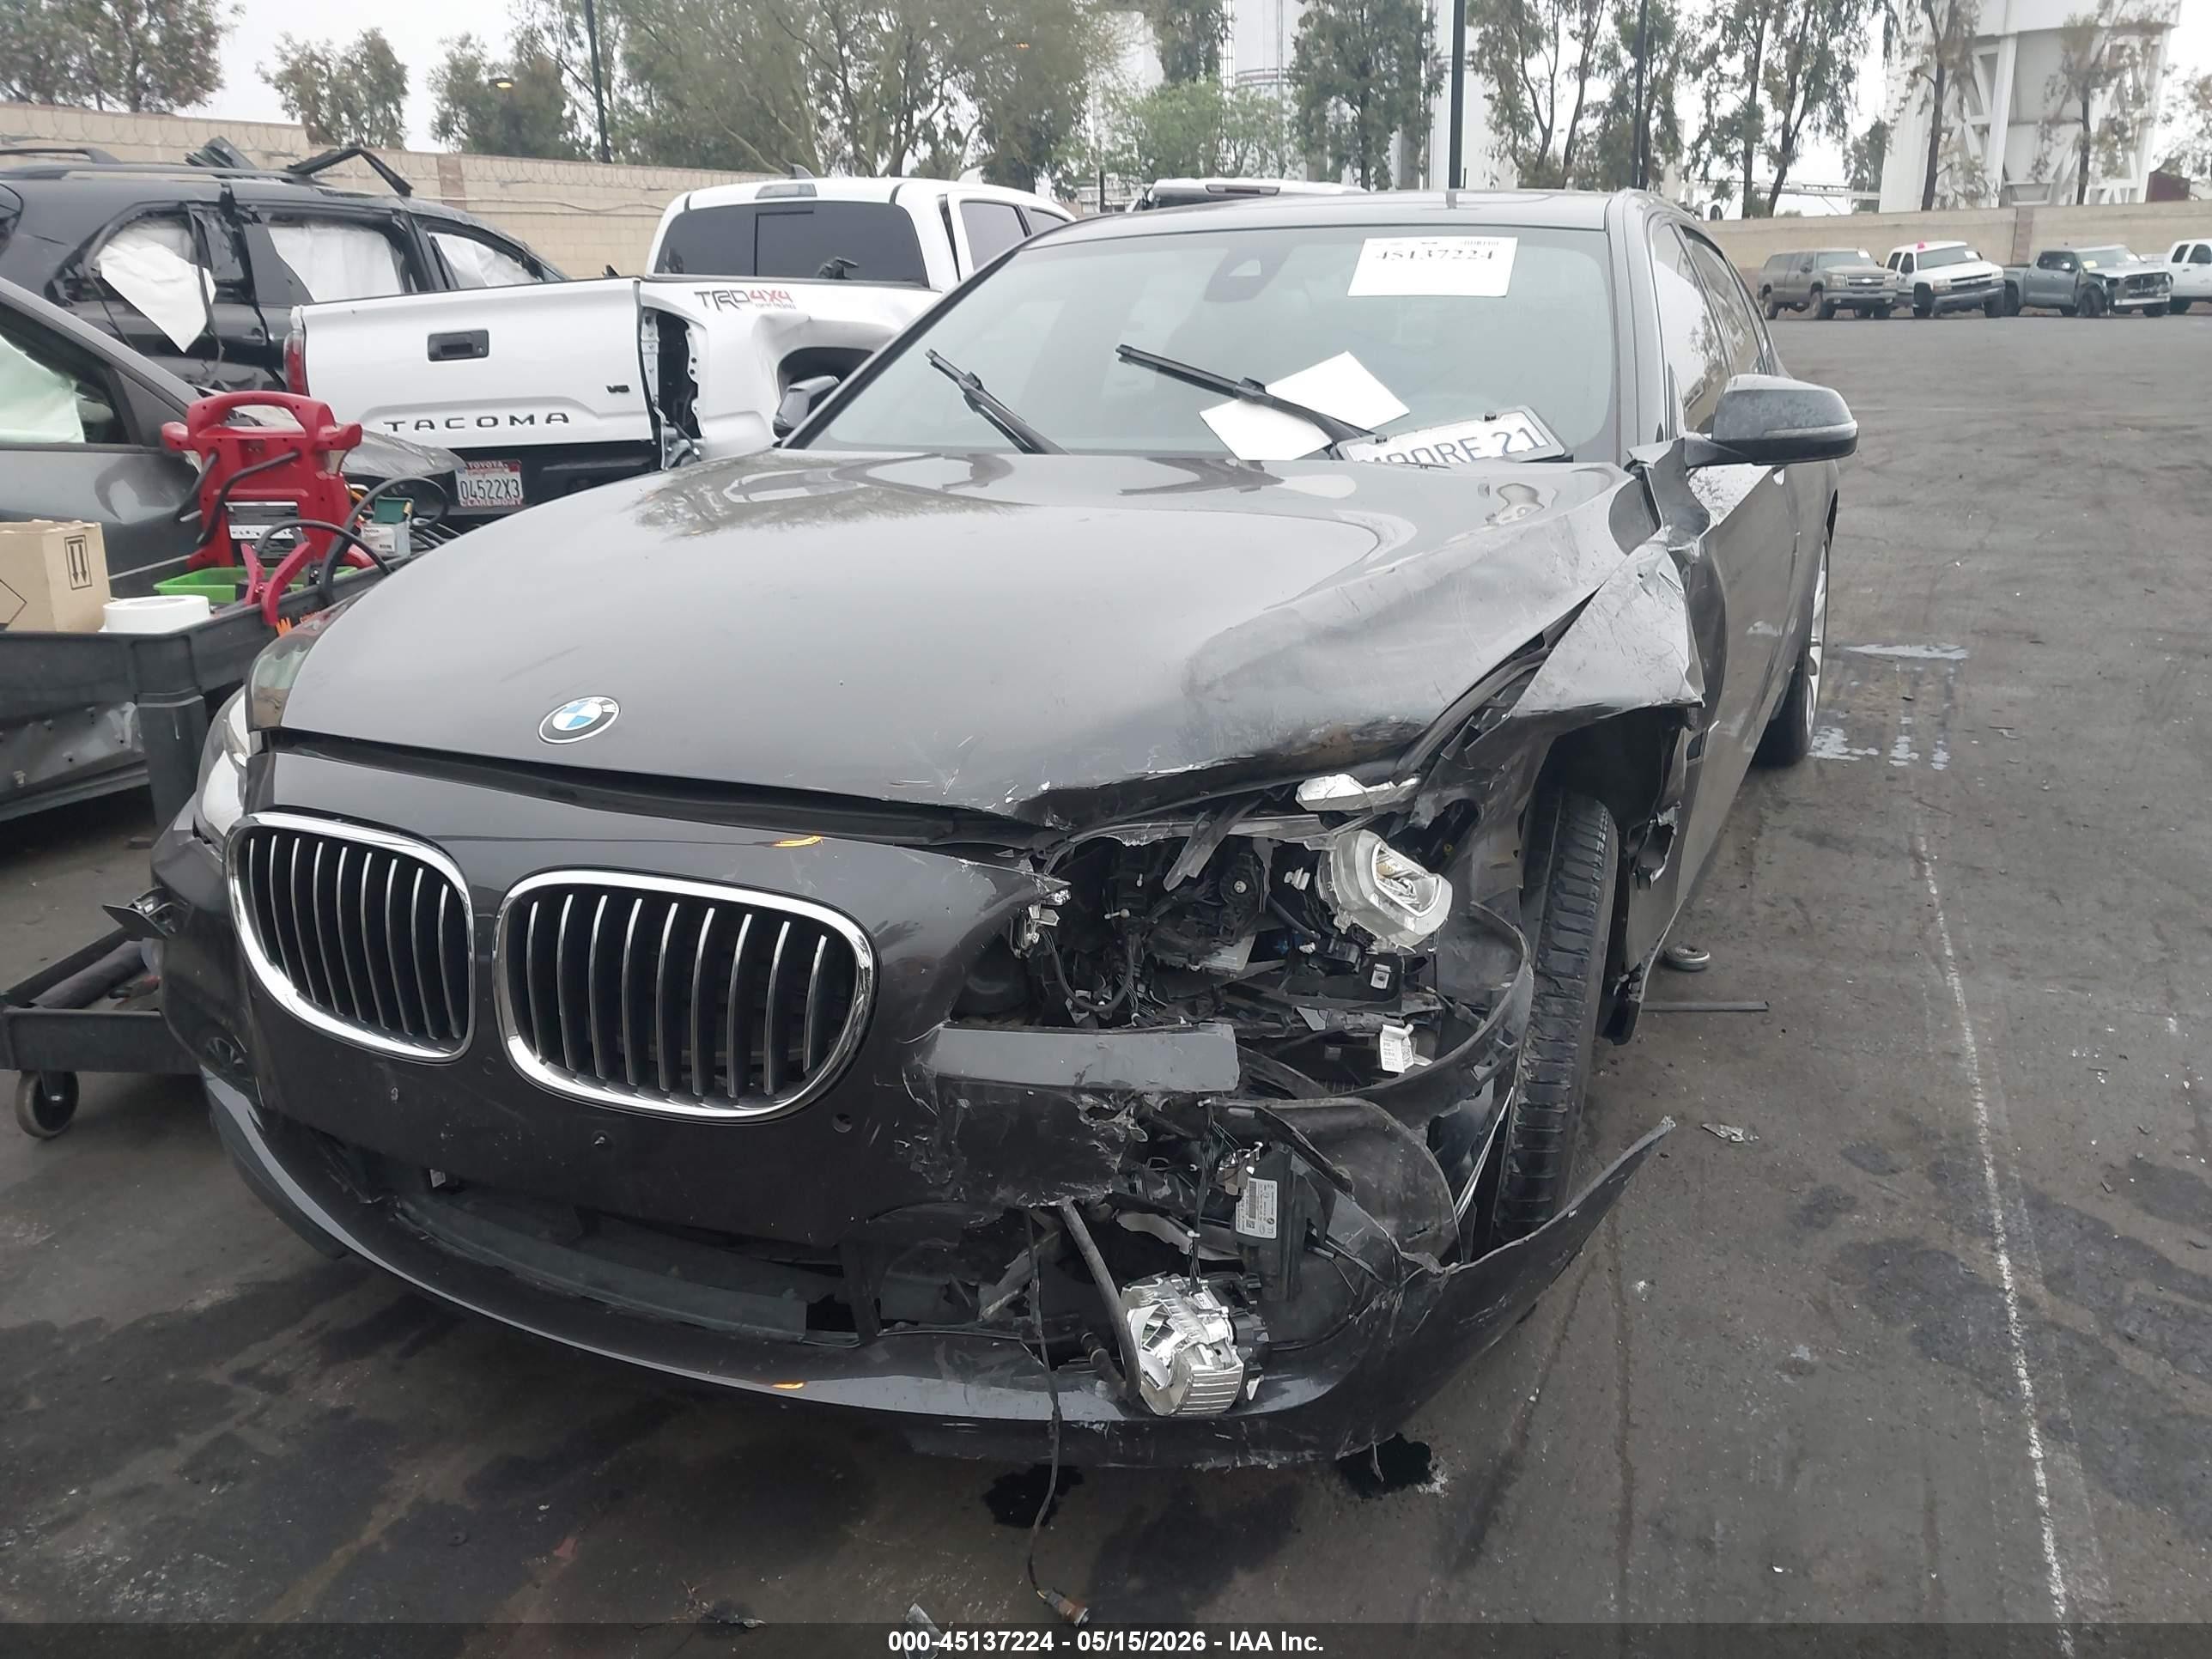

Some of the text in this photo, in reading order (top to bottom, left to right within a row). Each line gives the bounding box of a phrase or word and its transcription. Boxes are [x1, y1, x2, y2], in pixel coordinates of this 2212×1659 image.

[694, 289, 750, 311] TRD
[383, 412, 569, 432] TACOMA
[1359, 427, 1549, 464] ORE 21
[460, 478, 520, 500] 04522X3
